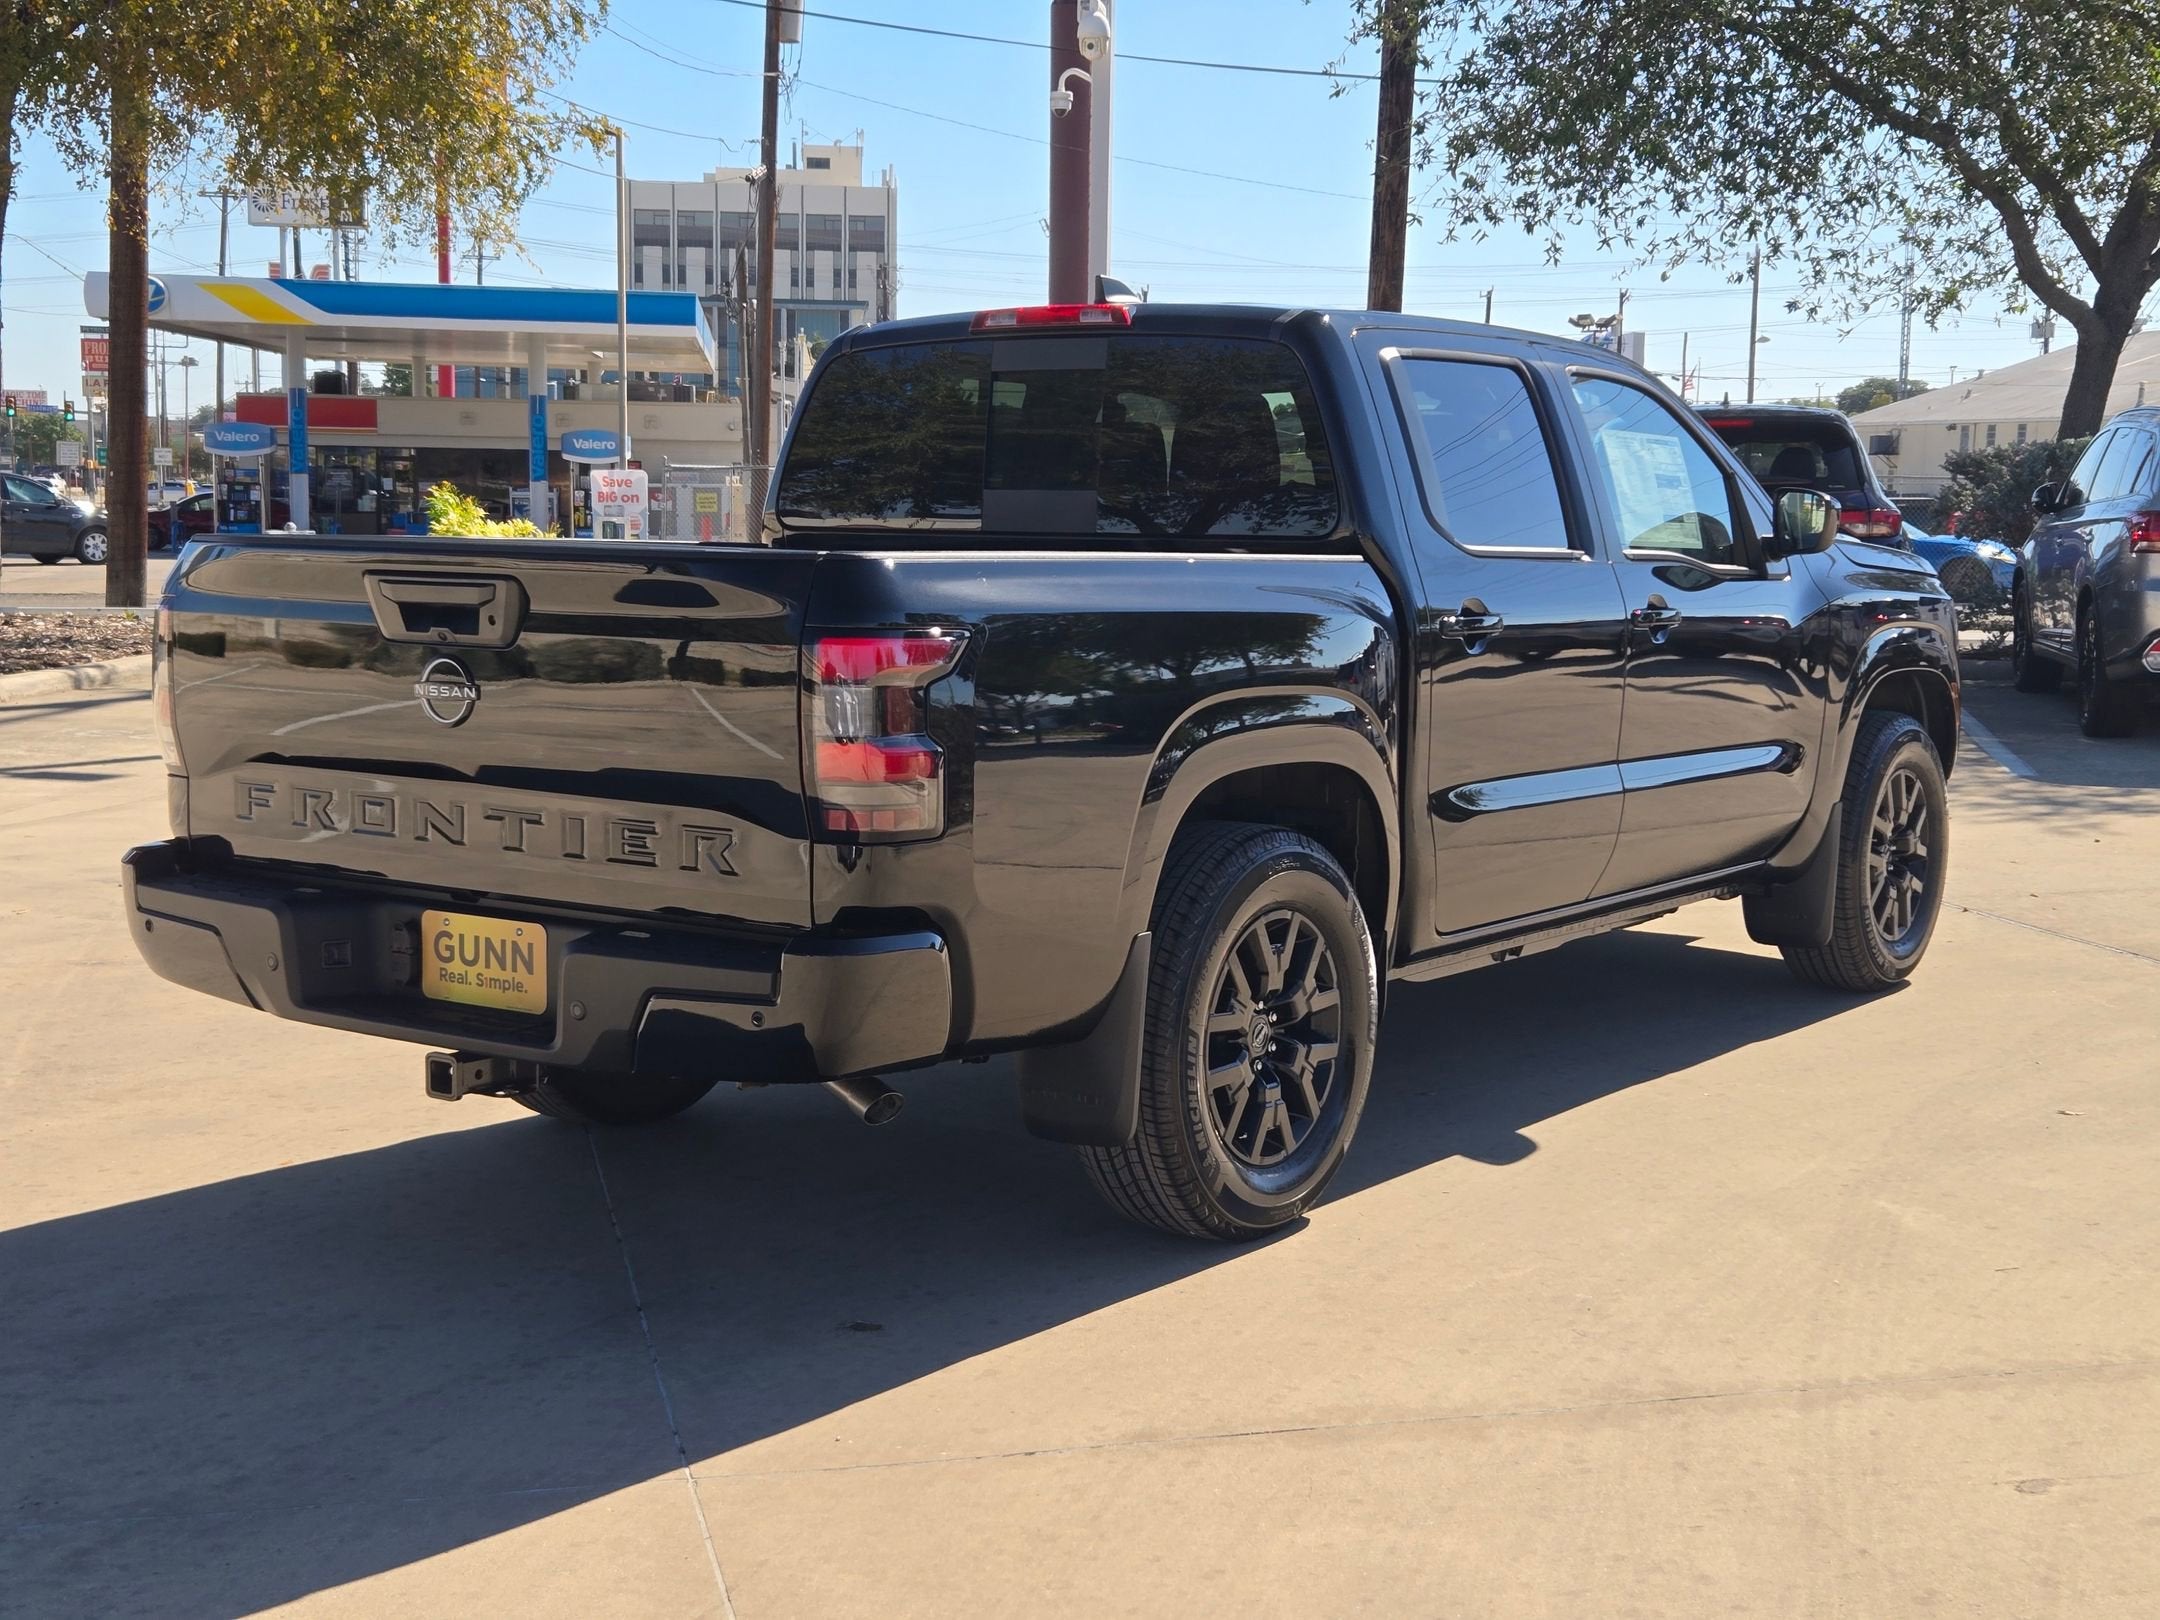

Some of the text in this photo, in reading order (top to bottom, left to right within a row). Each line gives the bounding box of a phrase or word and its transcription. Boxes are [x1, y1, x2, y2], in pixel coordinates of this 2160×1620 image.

[215, 431, 260, 442] Valero
[572, 438, 616, 450] Valero
[602, 476, 633, 488] Save
[597, 492, 640, 503] BIG on
[415, 684, 476, 698] NISSAN
[234, 779, 741, 877] FRONTIER
[433, 930, 534, 975] GUNN
[439, 967, 472, 986] Real.
[1187, 1036, 1209, 1151] MICHELIN
